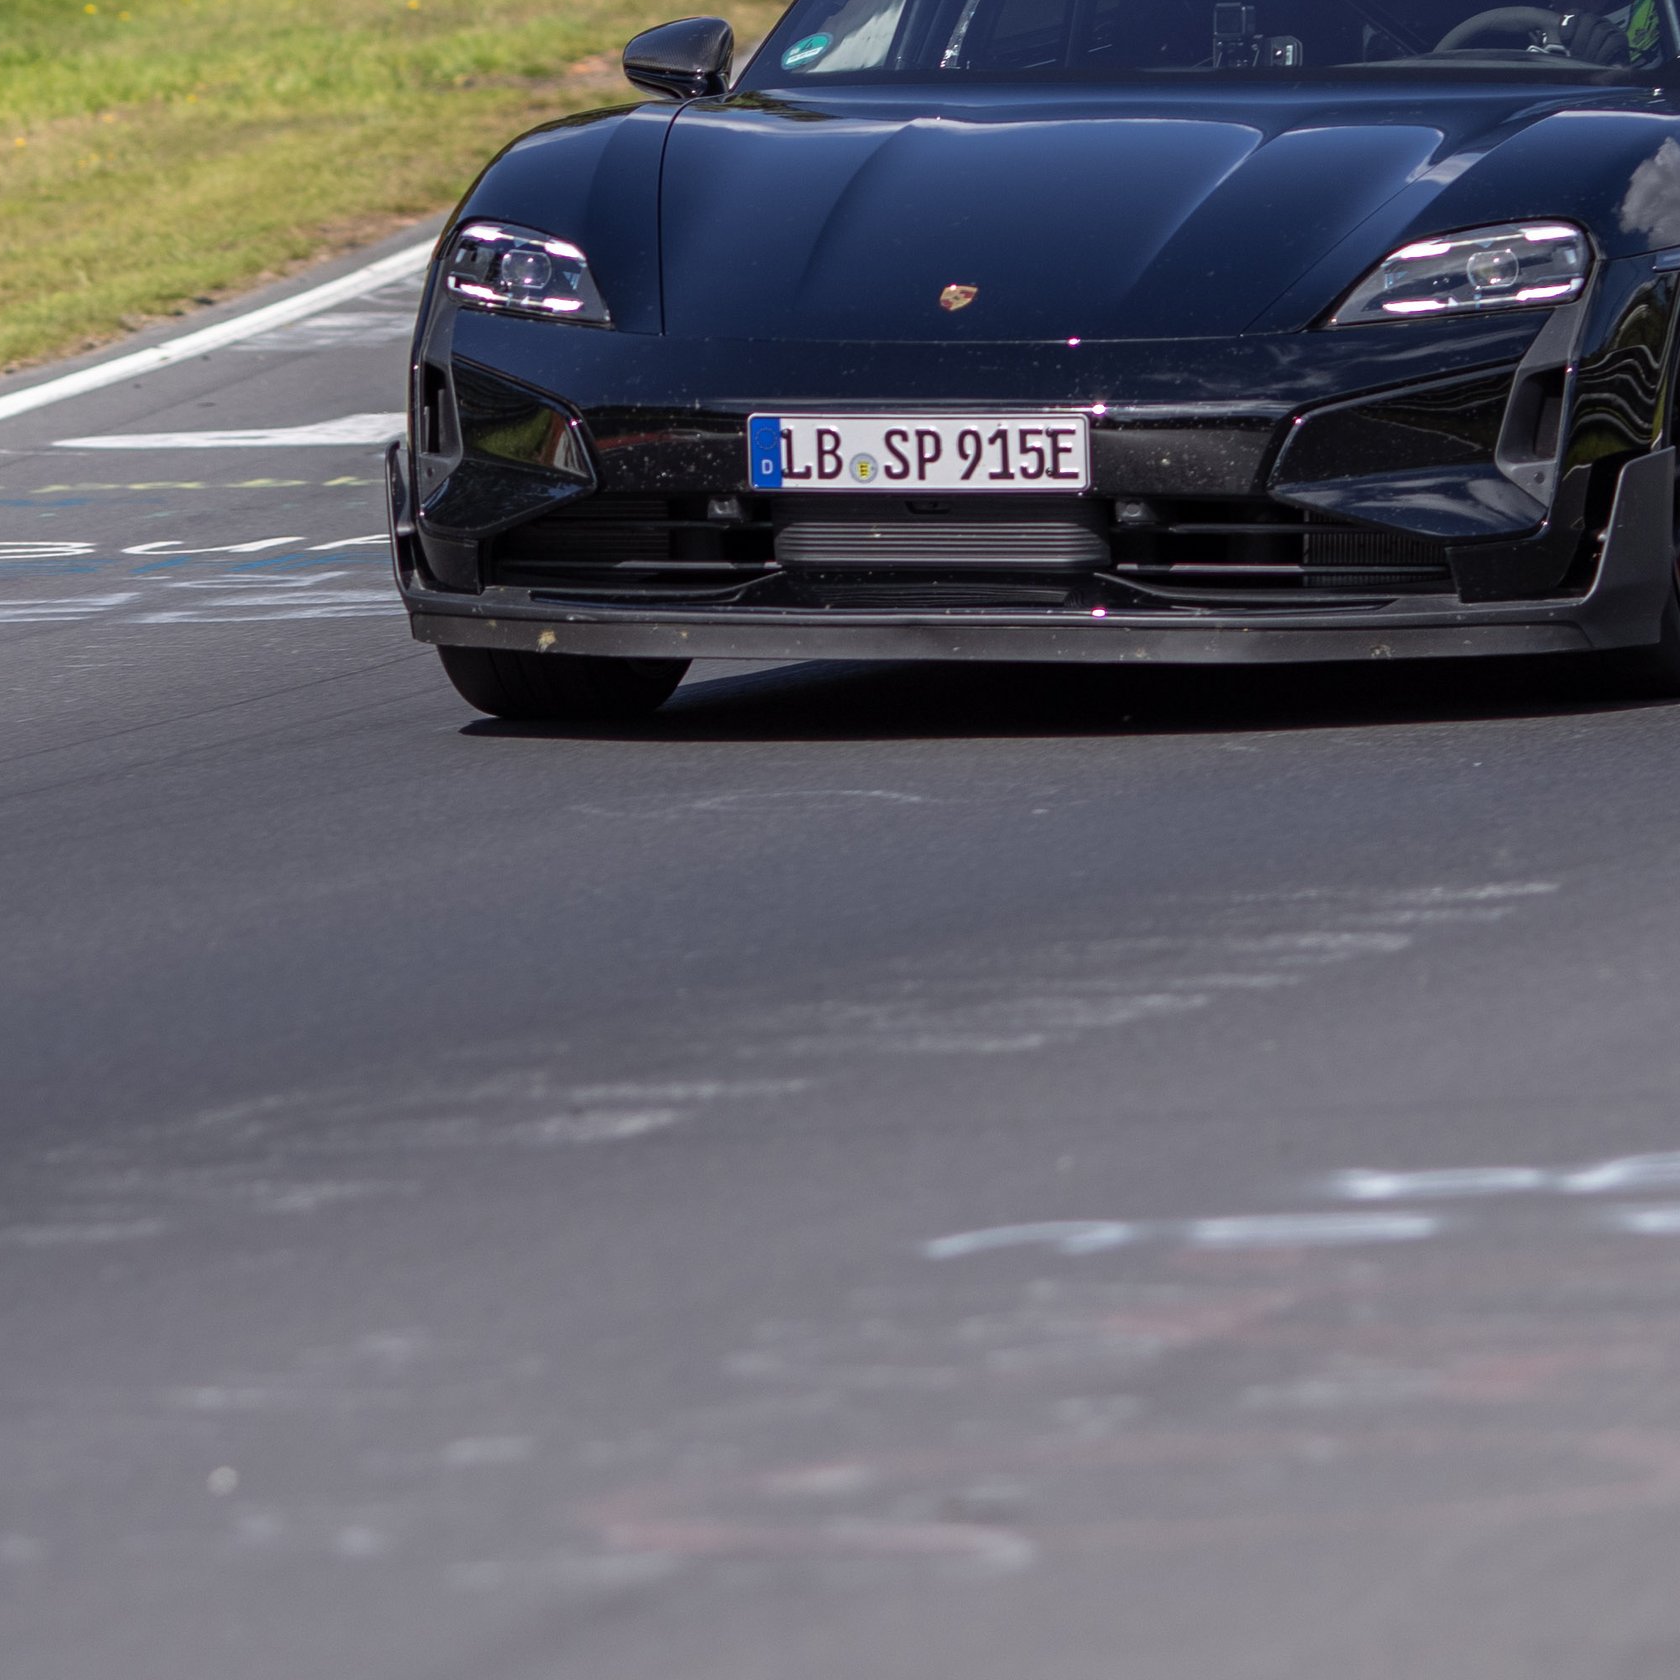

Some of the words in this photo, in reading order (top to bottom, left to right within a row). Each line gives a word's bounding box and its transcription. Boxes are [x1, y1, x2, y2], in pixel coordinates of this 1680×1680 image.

[761, 459, 773, 474] D
[782, 428, 843, 480] LB
[884, 428, 942, 480] SP
[957, 428, 1080, 480] 915E
